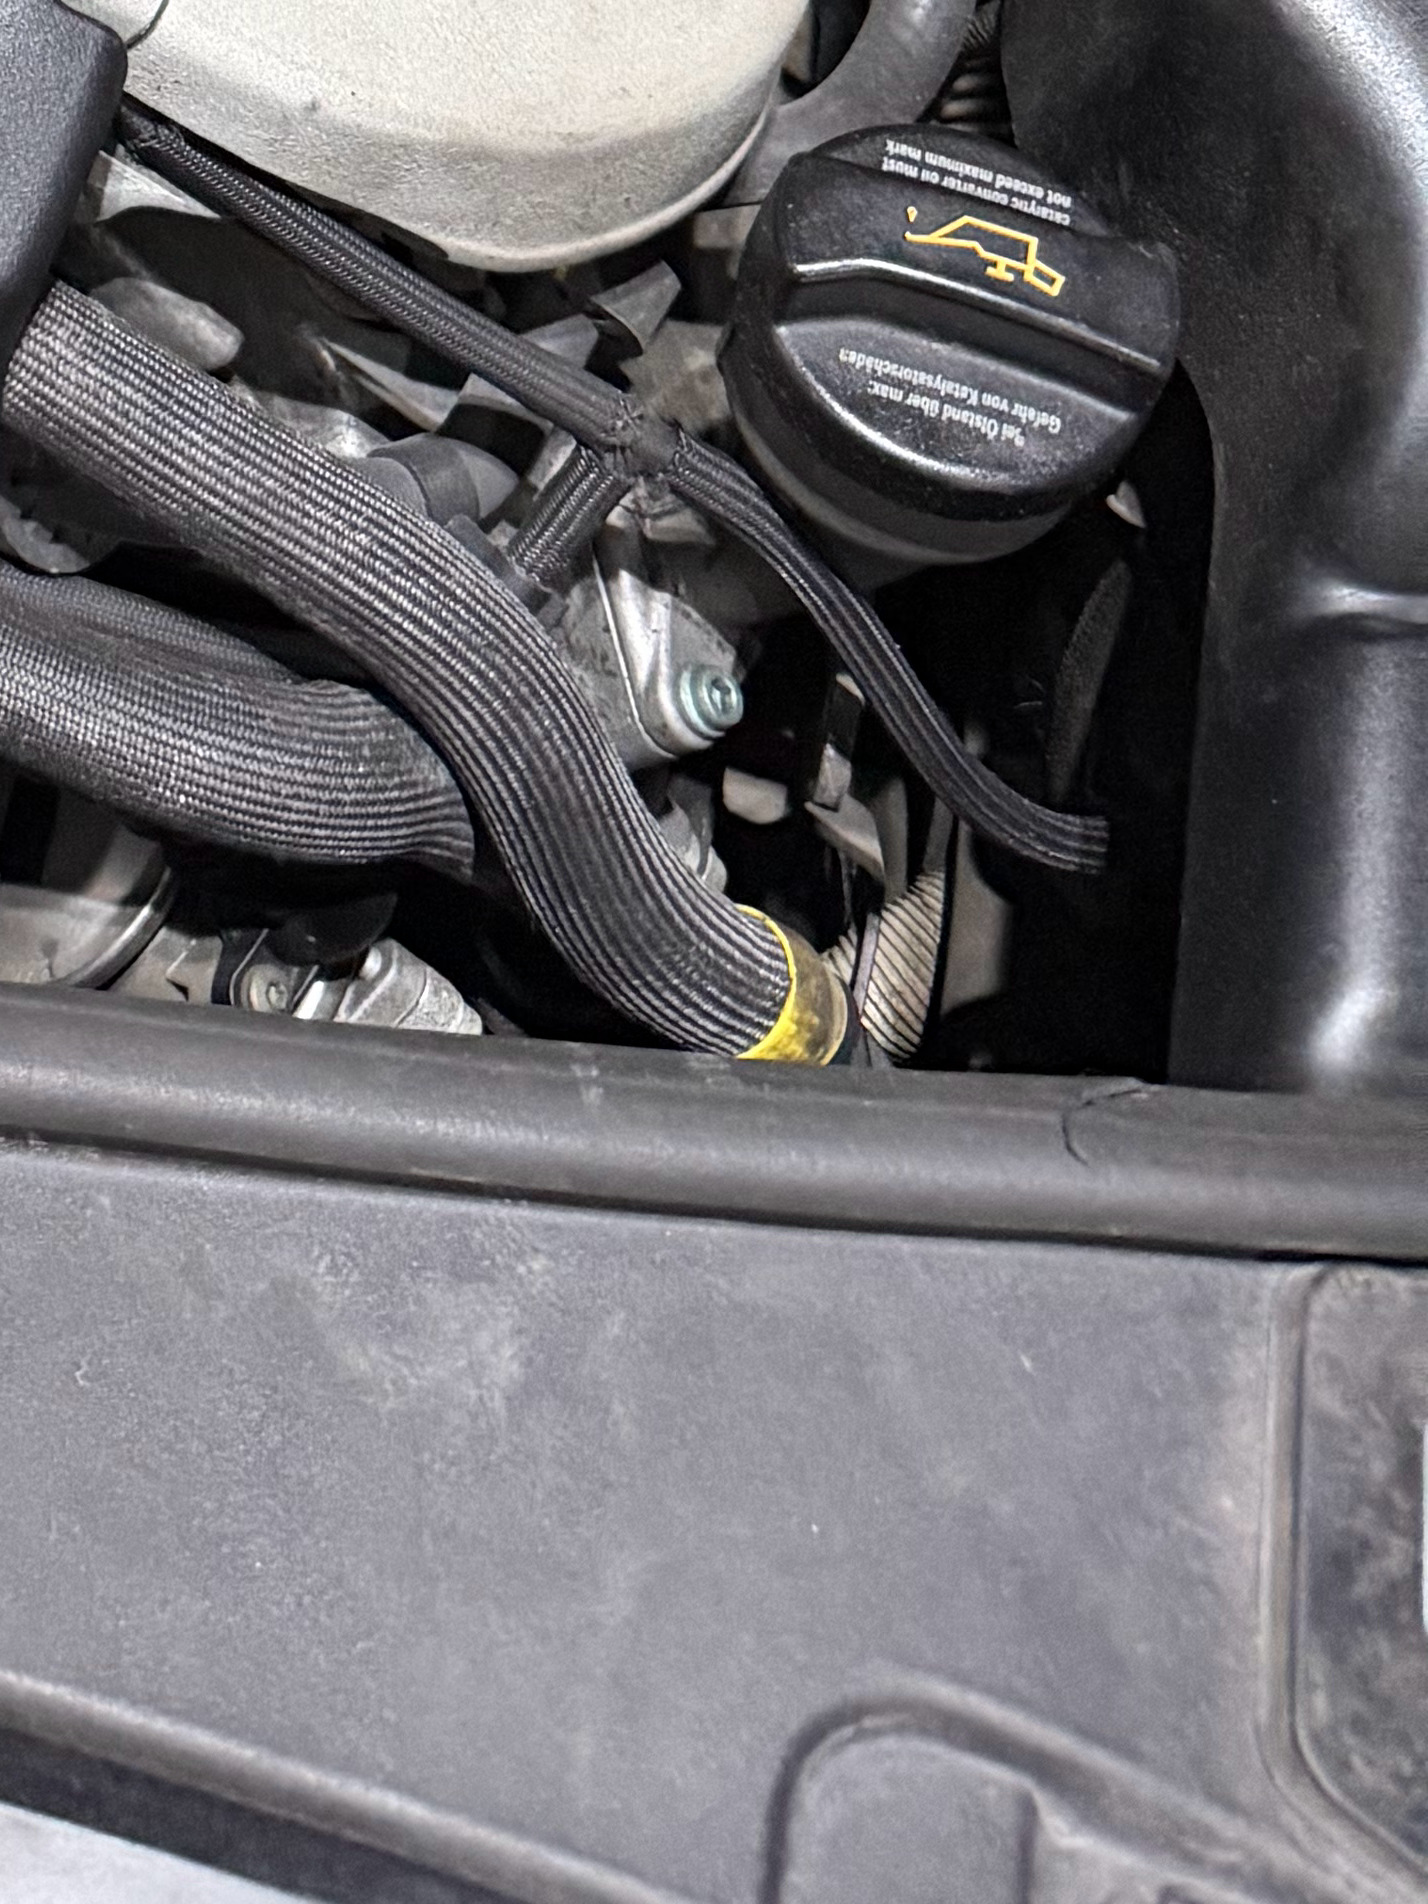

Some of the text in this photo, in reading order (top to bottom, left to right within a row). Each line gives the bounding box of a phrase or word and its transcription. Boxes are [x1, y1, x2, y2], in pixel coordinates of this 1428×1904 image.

[881, 155, 919, 179] must
[884, 138, 1073, 209] not exceed maximum mark
[941, 174, 1009, 206] converter
[1010, 196, 1071, 226] catalytic
[904, 391, 940, 419] über
[980, 391, 1010, 414] von
[1010, 401, 1062, 435] Gefahr
[941, 402, 999, 441] Ölstand
